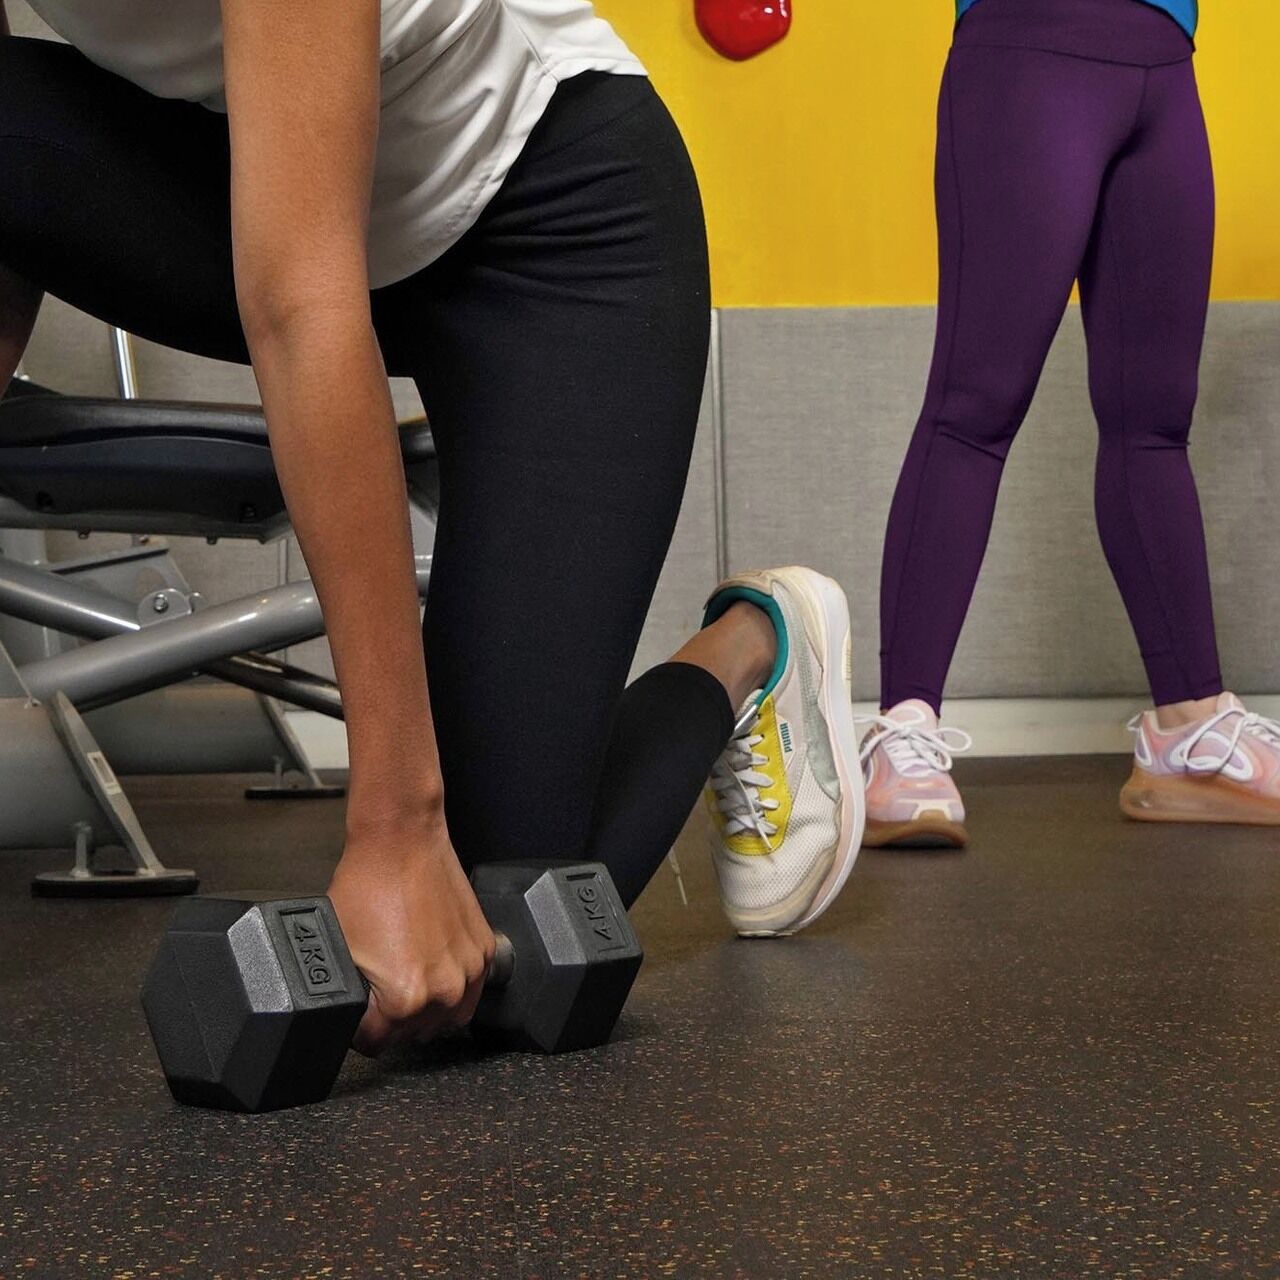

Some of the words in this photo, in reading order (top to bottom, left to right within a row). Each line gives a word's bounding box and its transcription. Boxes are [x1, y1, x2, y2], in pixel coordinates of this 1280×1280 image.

[779, 722, 793, 754] PUMA
[577, 886, 613, 941] 4KG
[293, 923, 332, 986] 4KG
